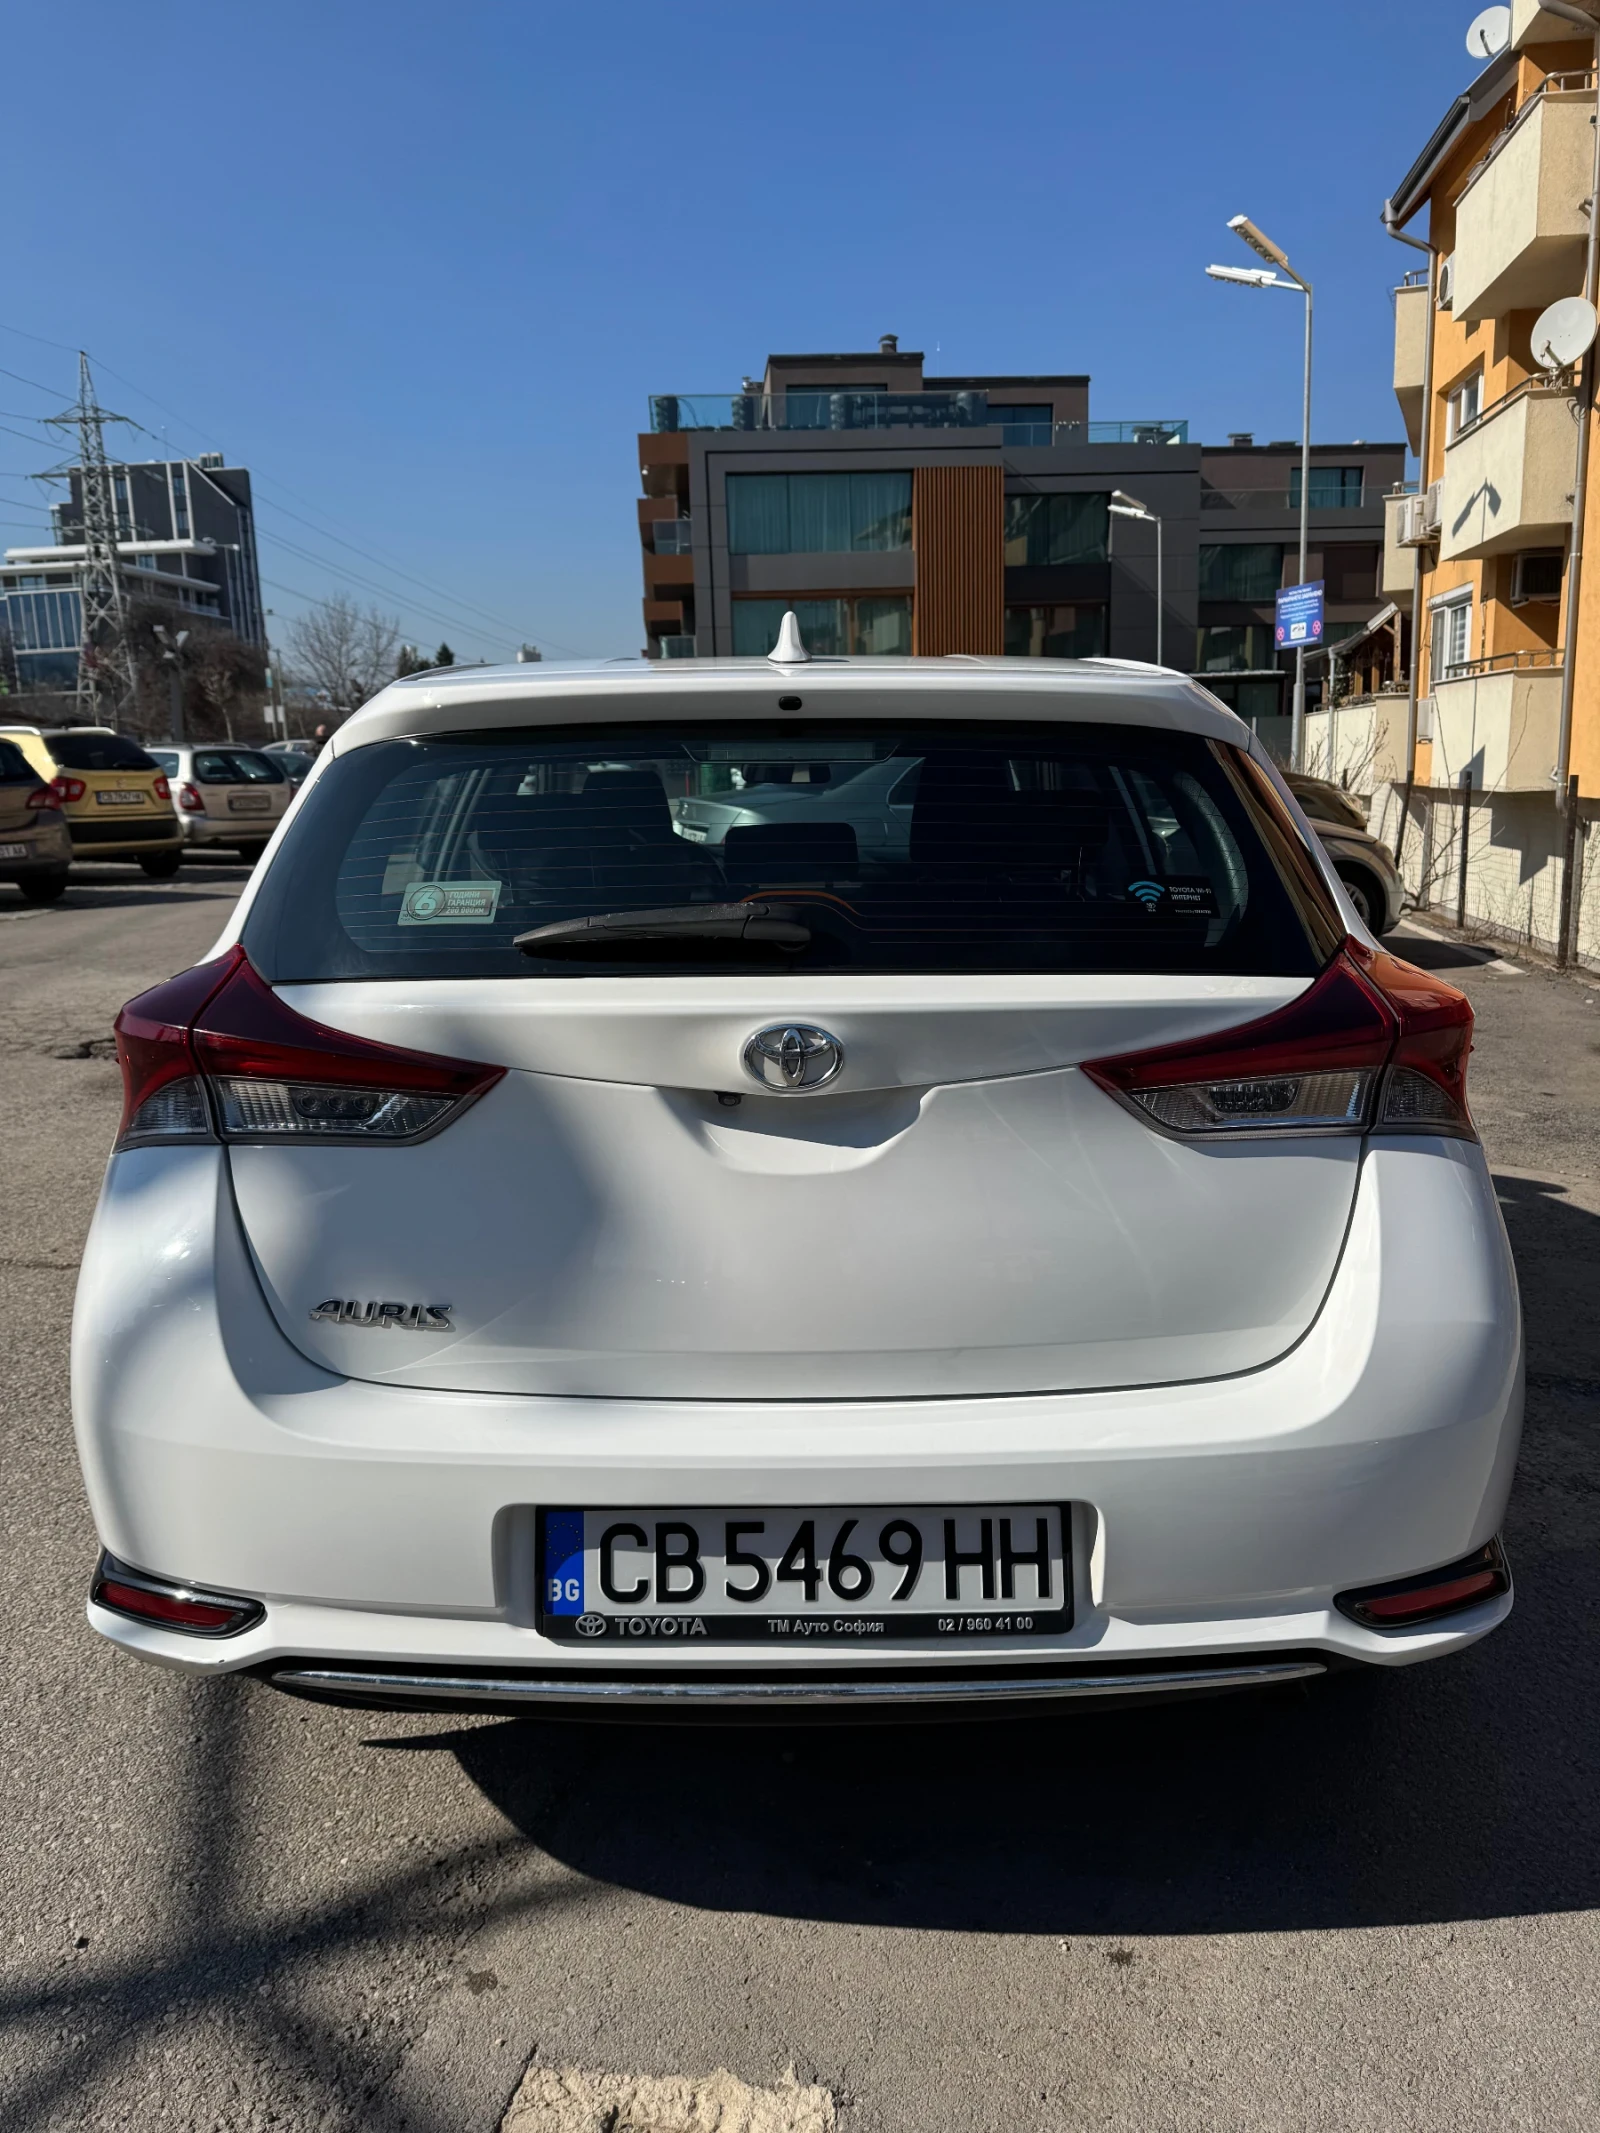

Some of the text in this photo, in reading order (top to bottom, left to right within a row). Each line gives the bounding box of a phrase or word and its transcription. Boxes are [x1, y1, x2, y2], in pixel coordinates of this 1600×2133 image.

[414, 889, 437, 916] 6
[447, 898, 487, 907] ГАРАНЦИЯ
[449, 891, 481, 899] ГОДИНИ
[309, 1298, 454, 1330] AURIS
[599, 1518, 1053, 1604] CB 5469 HH
[547, 1578, 580, 1602] BG
[615, 1617, 708, 1636] TOYOTA
[767, 1618, 886, 1637] ТМ Ауто София
[937, 1618, 956, 1632] 02
[966, 1617, 993, 1631] 960
[995, 1616, 1012, 1631] 41
[1016, 1616, 1034, 1630] 00
